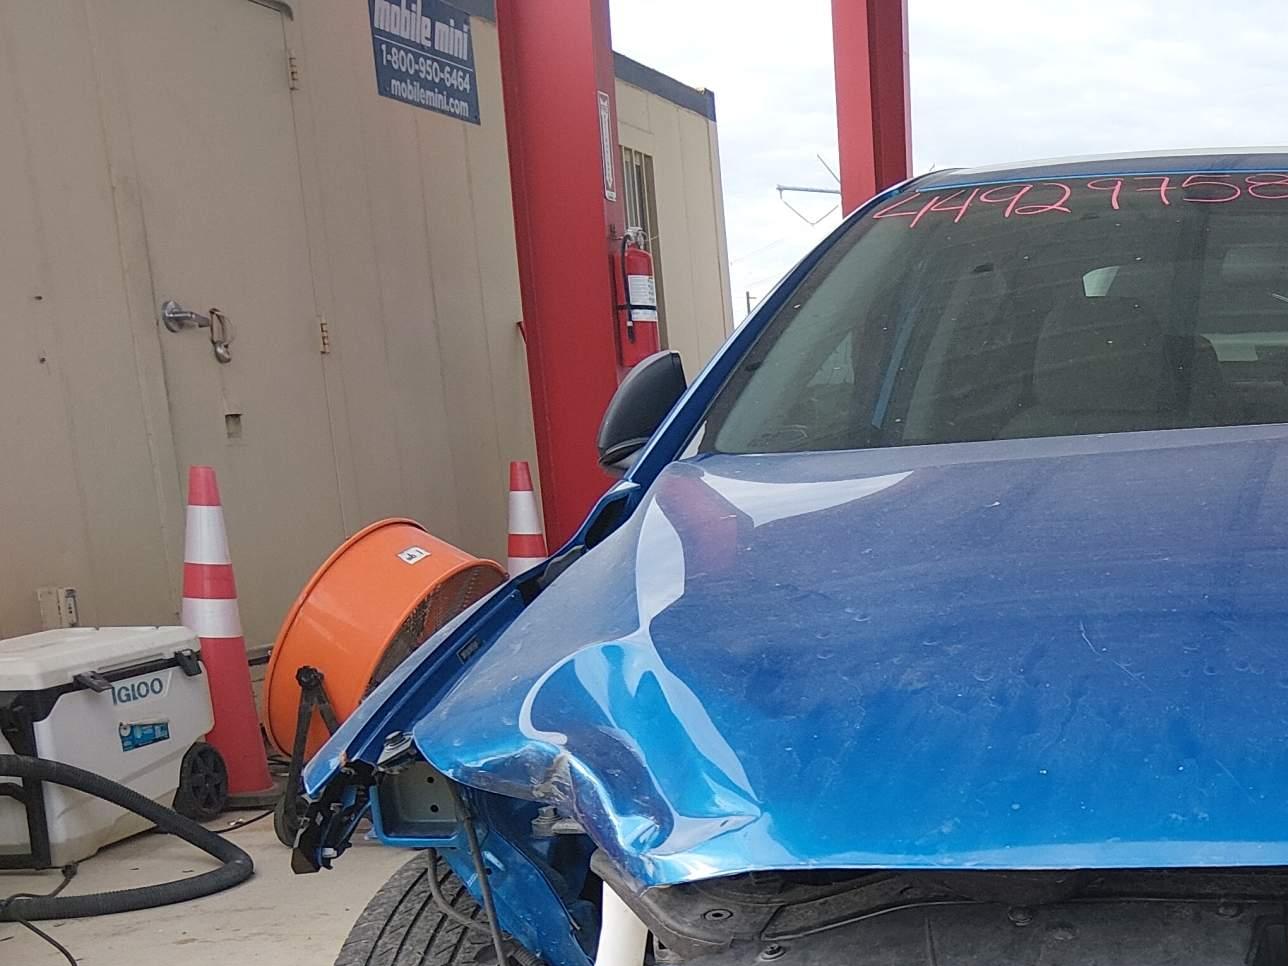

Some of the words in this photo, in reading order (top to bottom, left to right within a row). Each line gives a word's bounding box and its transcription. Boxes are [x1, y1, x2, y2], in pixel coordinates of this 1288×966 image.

[374, 0, 432, 48] mobile
[434, 19, 469, 61] mini
[381, 44, 470, 94] 1-800-950-6464
[391, 79, 469, 118] mobilemini.com
[111, 678, 164, 705] IGLOO
